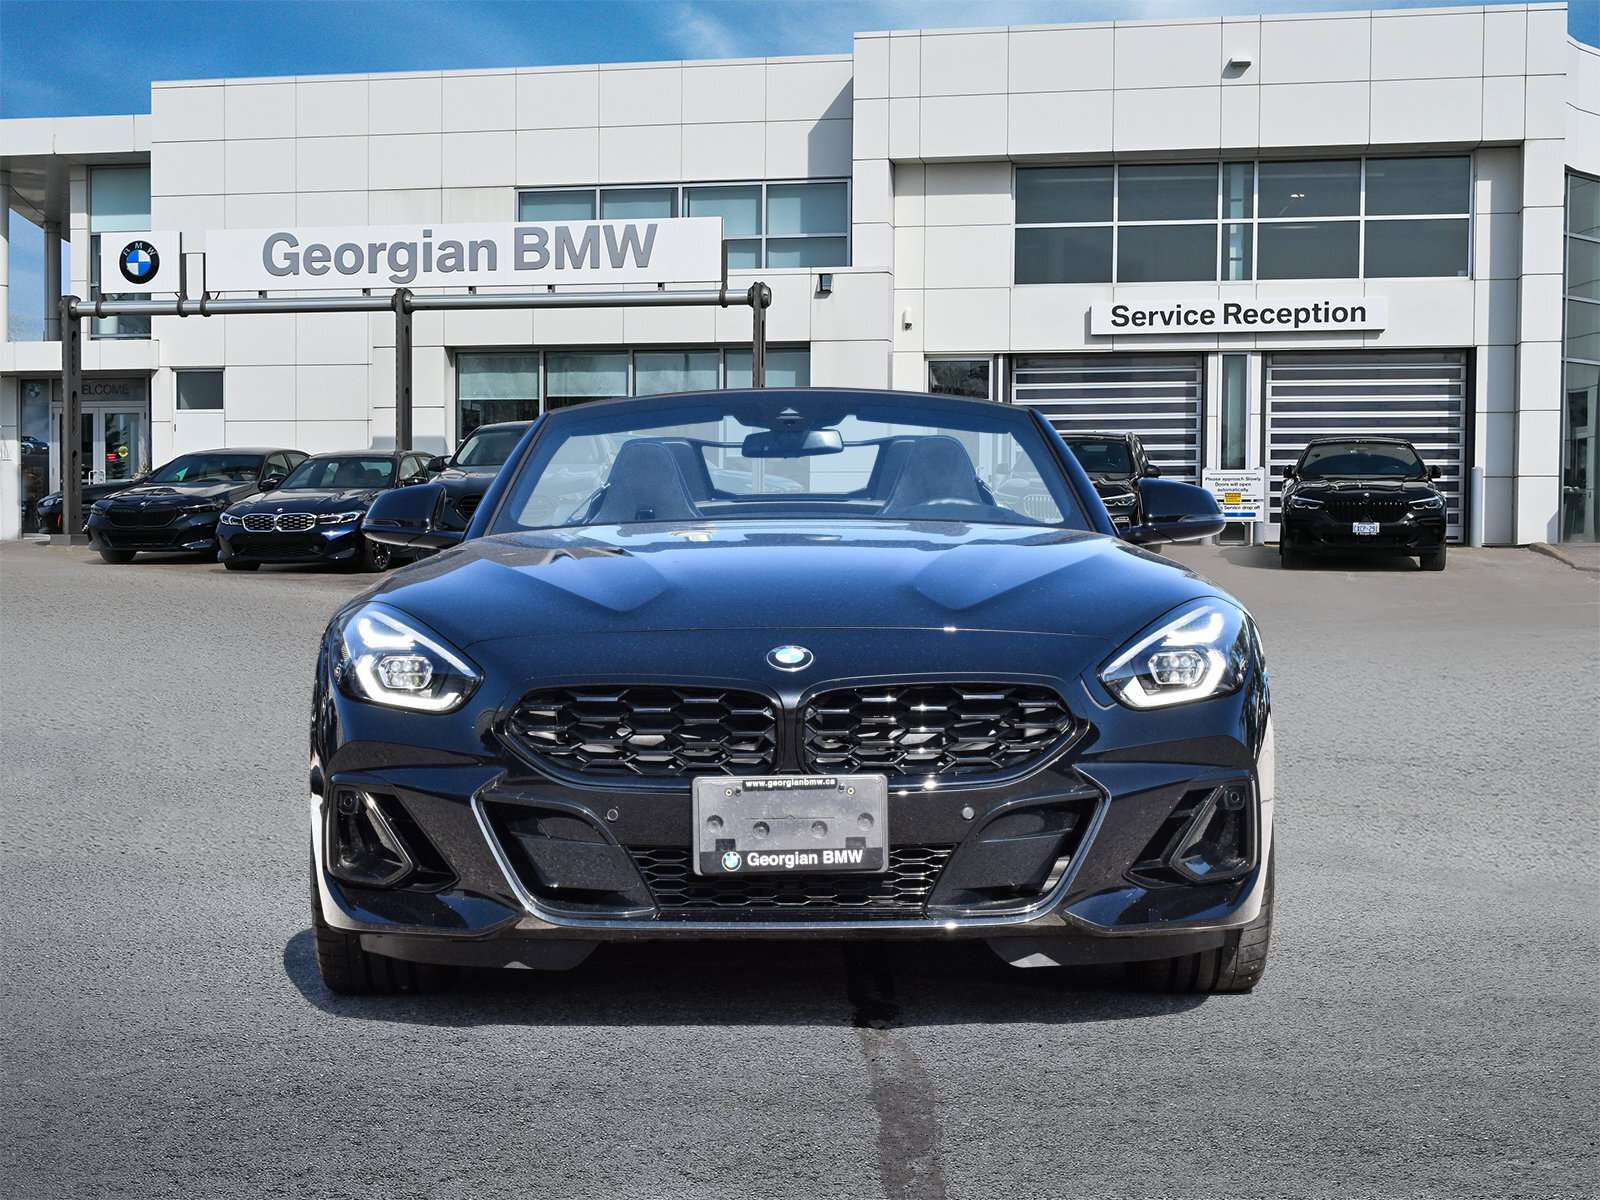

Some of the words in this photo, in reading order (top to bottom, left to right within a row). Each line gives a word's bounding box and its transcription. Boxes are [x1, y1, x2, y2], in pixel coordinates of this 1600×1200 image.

[262, 229, 498, 284] Georgian
[513, 223, 658, 271] BMW
[1110, 304, 1216, 328] Service
[1223, 301, 1366, 328] Reception
[81, 384, 129, 395] ELCOME
[745, 778, 836, 788] www.georgianbmw.ca
[747, 851, 819, 869] Georgian
[822, 849, 863, 864] BMW
